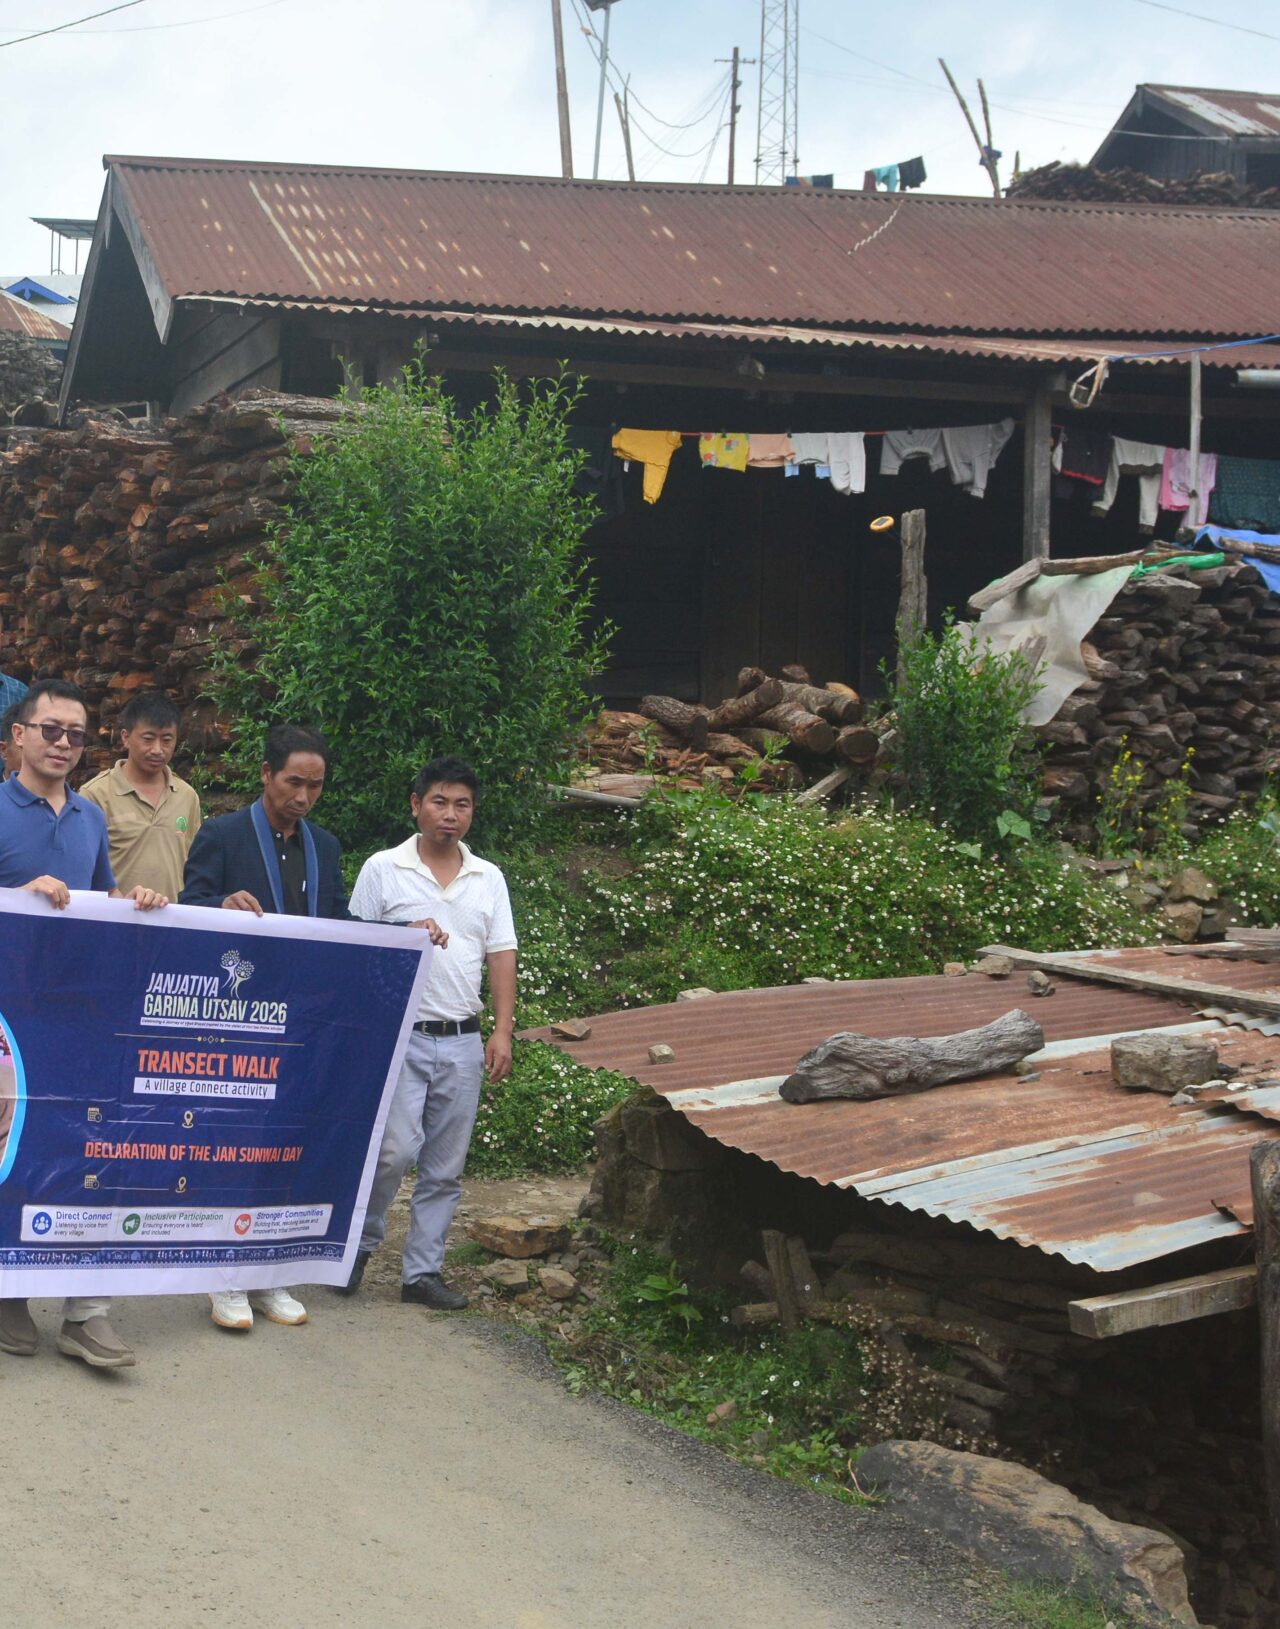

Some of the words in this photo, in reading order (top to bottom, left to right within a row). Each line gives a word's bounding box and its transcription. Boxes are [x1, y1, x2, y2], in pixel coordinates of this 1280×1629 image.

[146, 972, 220, 998] JANJATIYA
[143, 994, 199, 1018] GARIMA
[202, 998, 248, 1021] UTSAV
[249, 1001, 288, 1024] 2026
[137, 1049, 228, 1077] TRANSECT
[232, 1055, 280, 1079] WALK
[145, 1079, 151, 1090] A
[154, 1079, 186, 1094] village
[190, 1081, 229, 1095] Connect
[232, 1083, 269, 1099] activity
[85, 1141, 167, 1160] DECLARATION
[170, 1145, 185, 1161] OF
[188, 1145, 211, 1161] THE
[212, 1146, 236, 1162] JAN
[239, 1147, 282, 1163] SUNWAI
[282, 1146, 304, 1162] DAY
[56, 1211, 80, 1220] Direct
[82, 1212, 112, 1220] Connect
[144, 1213, 177, 1221] Inclusive
[178, 1212, 224, 1222] Participation
[256, 1211, 284, 1221] Stronger
[285, 1208, 324, 1218] Communities
